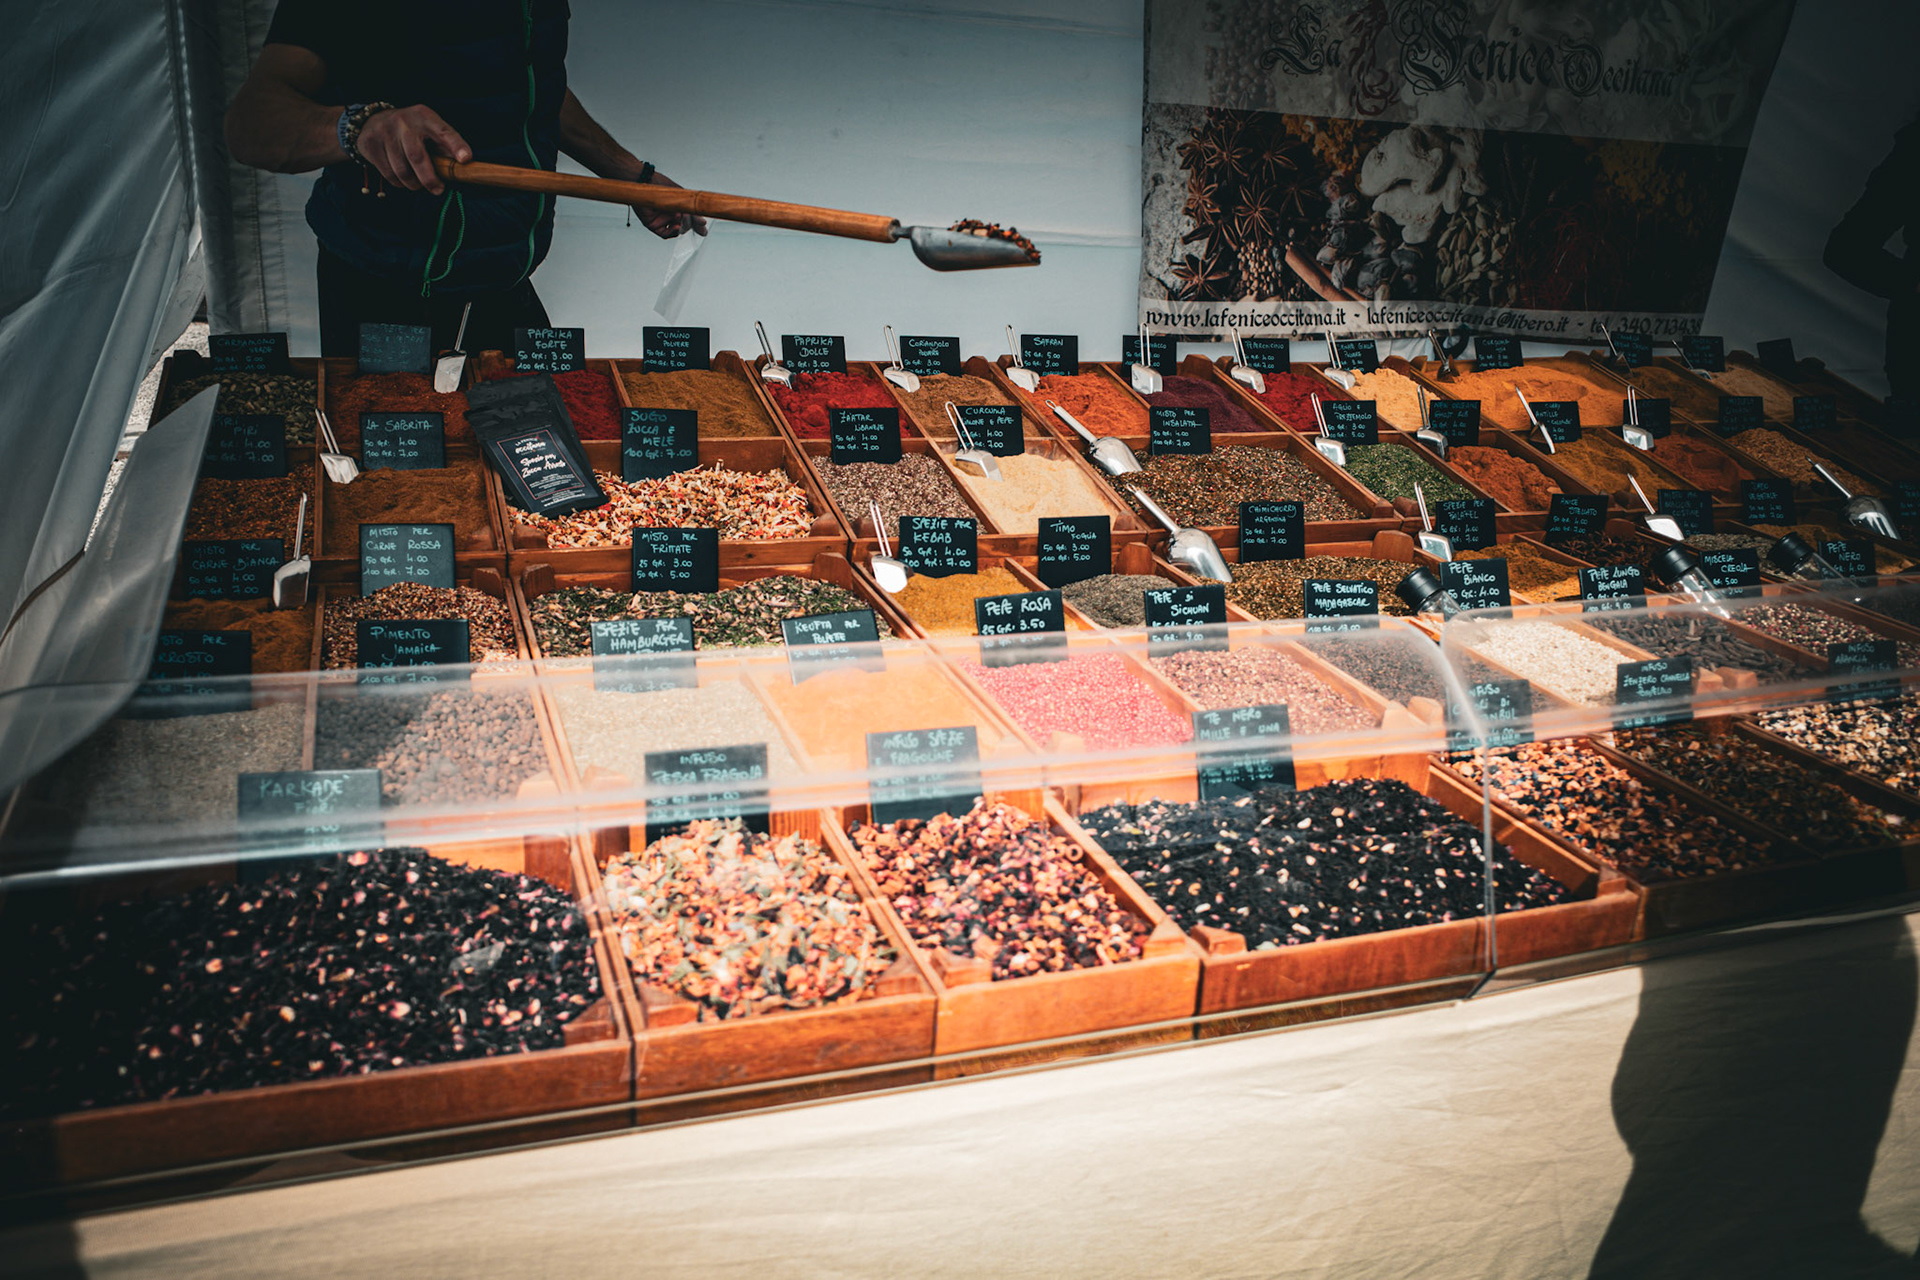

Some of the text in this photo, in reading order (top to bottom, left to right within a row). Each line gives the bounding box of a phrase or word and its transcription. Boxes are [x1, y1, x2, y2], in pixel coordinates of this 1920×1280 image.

[1259, 3, 1342, 77] La
[1146, 308, 1352, 328] www.lafeniceoccitana.it
[1366, 307, 1568, 333] lafeniceoccitana@libero.it
[528, 328, 573, 340] PAPRIKA
[656, 331, 690, 340] CUMINO
[535, 340, 568, 350] FORTE
[793, 335, 834, 347] PAPRIKA
[908, 339, 949, 350] CORIANDOLO
[517, 350, 573, 361] 50 3.00
[670, 350, 687, 358] 3.00
[799, 347, 829, 358] DOLCE
[1046, 350, 1061, 360] 5.00
[517, 362, 571, 371] 100 5.00
[669, 359, 686, 368] 5.00
[812, 360, 830, 369] 3.00
[631, 410, 668, 423] SUGO
[965, 407, 1006, 417] CURCUMA
[365, 417, 433, 432] LA SAPORITA
[627, 423, 659, 436] ZUCCA
[861, 433, 878, 442] 4.00
[986, 429, 1004, 439] 4.00
[365, 436, 418, 447] 50 4.00
[643, 436, 676, 447] MELE
[861, 442, 881, 452] 7.00
[987, 440, 1004, 450] 7.00
[399, 448, 419, 459] 7.00
[624, 448, 693, 460] 100 7.00
[912, 517, 973, 531] SPEZIE PER
[1050, 520, 1076, 533] TIMO
[369, 527, 434, 537] MISTO PER
[641, 530, 698, 542] MISTO PER
[1270, 526, 1286, 535] 4.00
[913, 532, 952, 544] KEBAB
[1270, 536, 1287, 544] 7.00
[366, 539, 442, 551] CARNE ROSSA
[902, 546, 967, 556] 50 4.00
[1043, 543, 1090, 552] 50 3.00
[1826, 541, 1847, 554] PEPE
[365, 553, 429, 564] 50 4.00
[673, 557, 693, 568] 3.00
[1072, 552, 1091, 562] 5.00
[1839, 551, 1861, 562] NERO
[192, 556, 280, 571] CARNE BIANCA
[945, 558, 971, 568] 7.00
[1448, 562, 1474, 575] PEPE
[363, 565, 430, 576] 100 7.00
[636, 570, 690, 579] 50 5.00
[1587, 568, 1609, 582] PEPE
[232, 573, 256, 583] 4.00
[1463, 573, 1496, 586] BIANCO
[1724, 577, 1739, 585] 5.00
[232, 585, 259, 594] 7.00
[1311, 581, 1374, 595] PEPE SELVATICO
[1479, 586, 1500, 598] 4.00
[984, 597, 1052, 616] PEPE ROSA
[1170, 603, 1210, 617] SICHUAN
[1314, 598, 1371, 611] MADAGASCAR
[370, 625, 431, 641] PIMENTO
[596, 620, 678, 637] SPEZIE PER
[981, 624, 996, 636] 25
[1019, 619, 1046, 631] 3.50
[202, 633, 228, 646] PER
[610, 633, 690, 651] HAMBURGER
[1185, 632, 1204, 643] 9.00
[157, 651, 215, 664] RROSTO
[381, 643, 443, 661] JAMAICA
[406, 672, 438, 684] 7.00
[1467, 683, 1501, 697] NFUSO
[1232, 707, 1262, 723] NERO
[1200, 727, 1231, 741] MILLE
[1258, 722, 1280, 734] UNA
[679, 751, 727, 765] INFUSO
[700, 765, 763, 782] FRAGOLA
